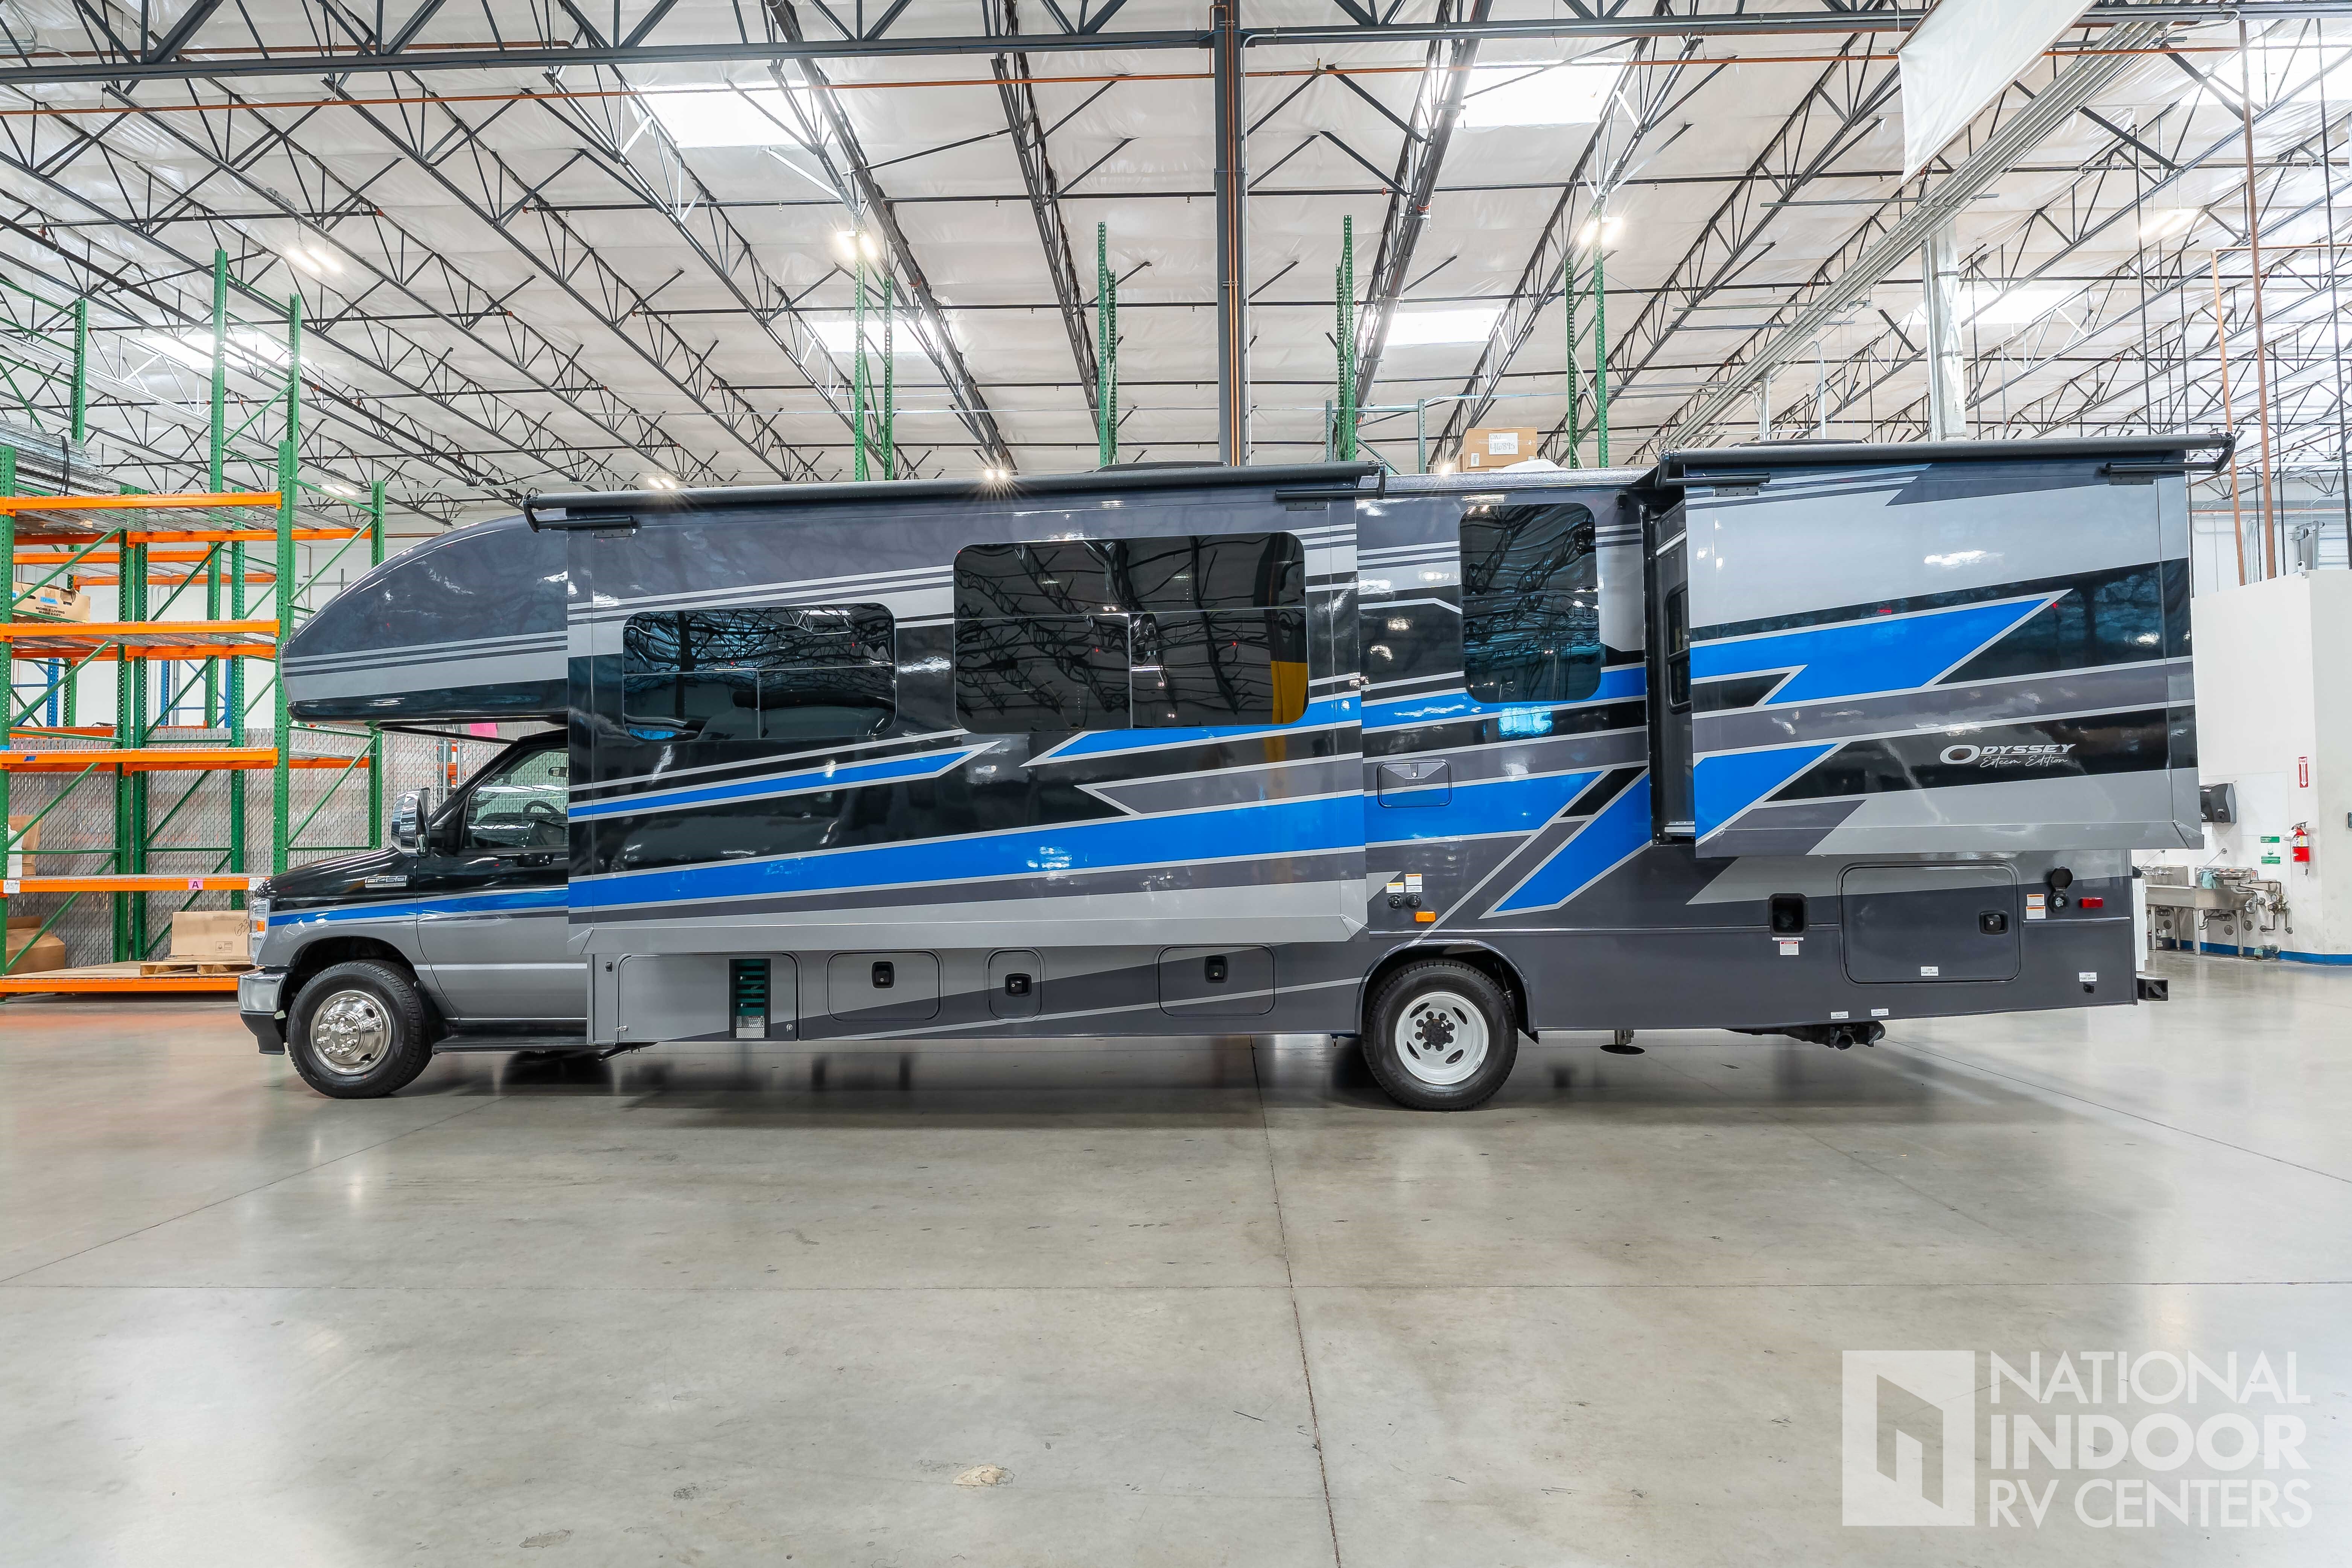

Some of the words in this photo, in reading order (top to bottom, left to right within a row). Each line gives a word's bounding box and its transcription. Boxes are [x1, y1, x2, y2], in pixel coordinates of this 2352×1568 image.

[1490, 442, 1515, 453] 46895
[1940, 744, 2076, 764] ODYSSEY
[1980, 756, 2022, 768] Esteem
[2025, 754, 2068, 767] Edition
[234, 919, 250, 937] 633
